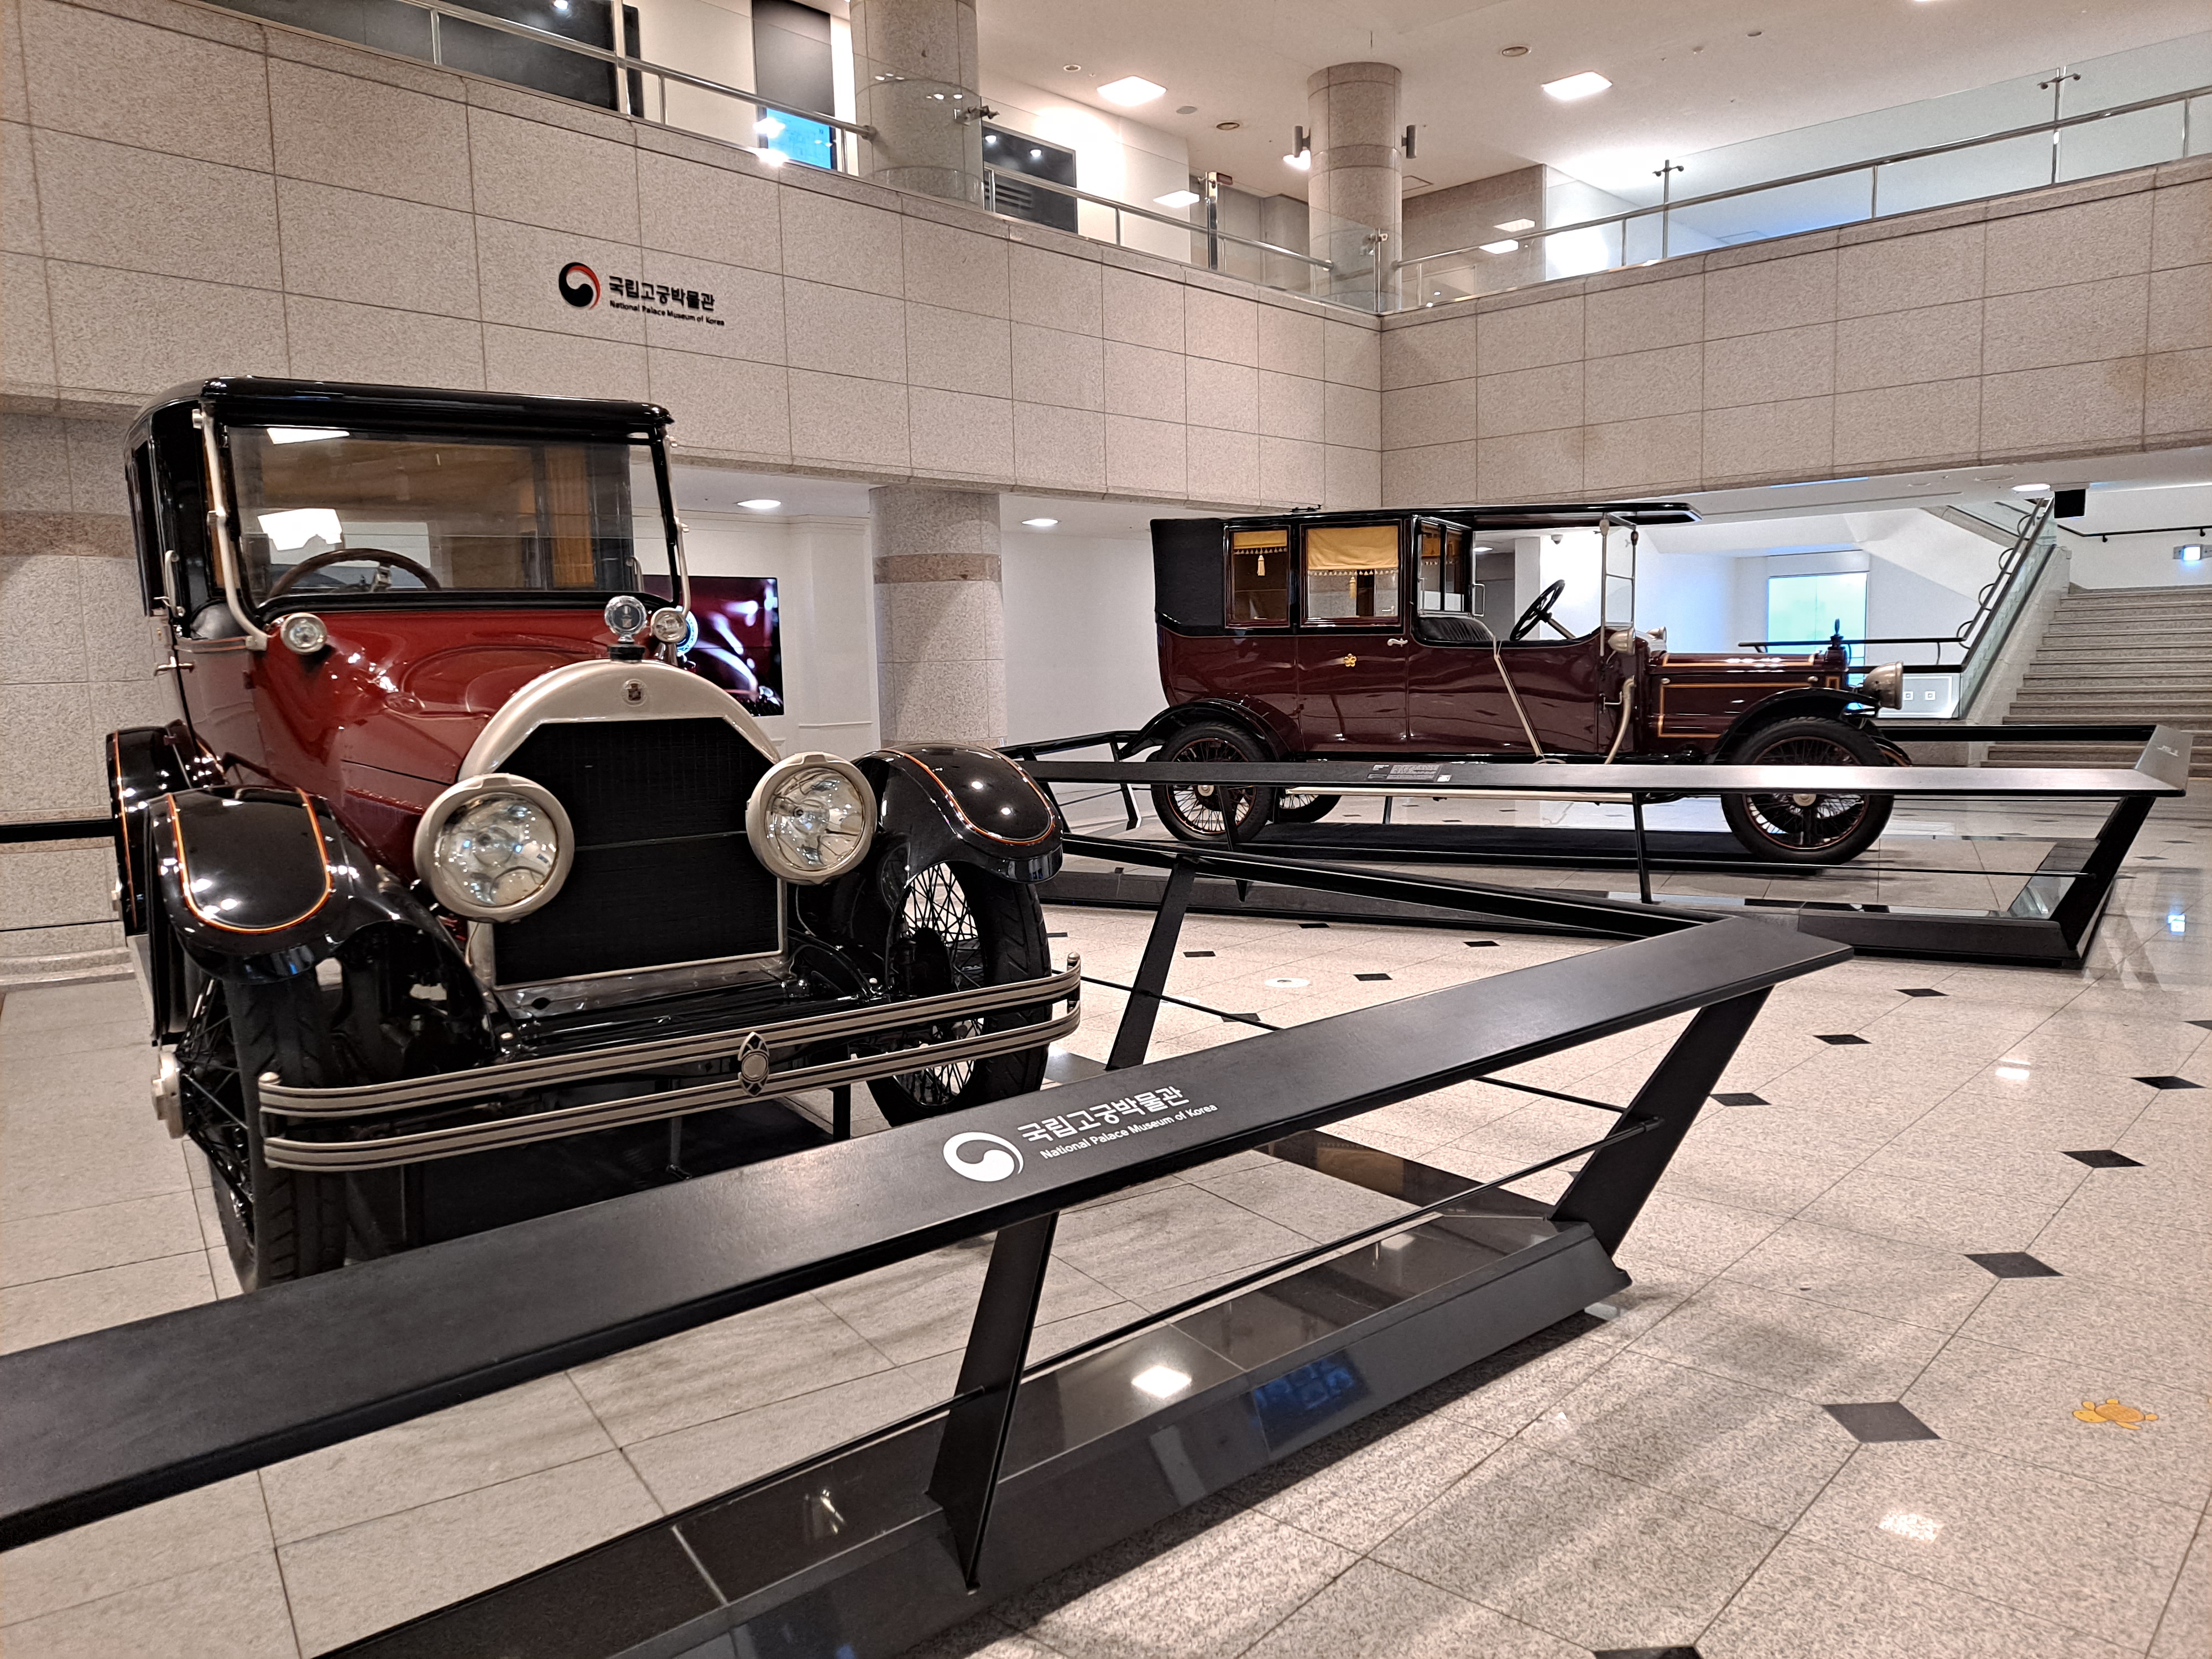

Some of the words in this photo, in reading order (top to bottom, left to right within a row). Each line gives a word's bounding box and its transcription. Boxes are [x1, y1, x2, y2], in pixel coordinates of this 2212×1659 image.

[609, 275, 715, 311] 국립고궁박물관
[610, 300, 640, 312] National
[642, 305, 666, 316] Palace
[667, 310, 695, 321] Museum
[706, 316, 724, 326] Korea
[1017, 1086, 1190, 1142] 국립고궁박물관
[1040, 1138, 1092, 1159] National
[1089, 1129, 1130, 1145] Palace
[1127, 1117, 1175, 1134] Museum
[1175, 1111, 1187, 1120] of
[1185, 1104, 1218, 1117] Korea
